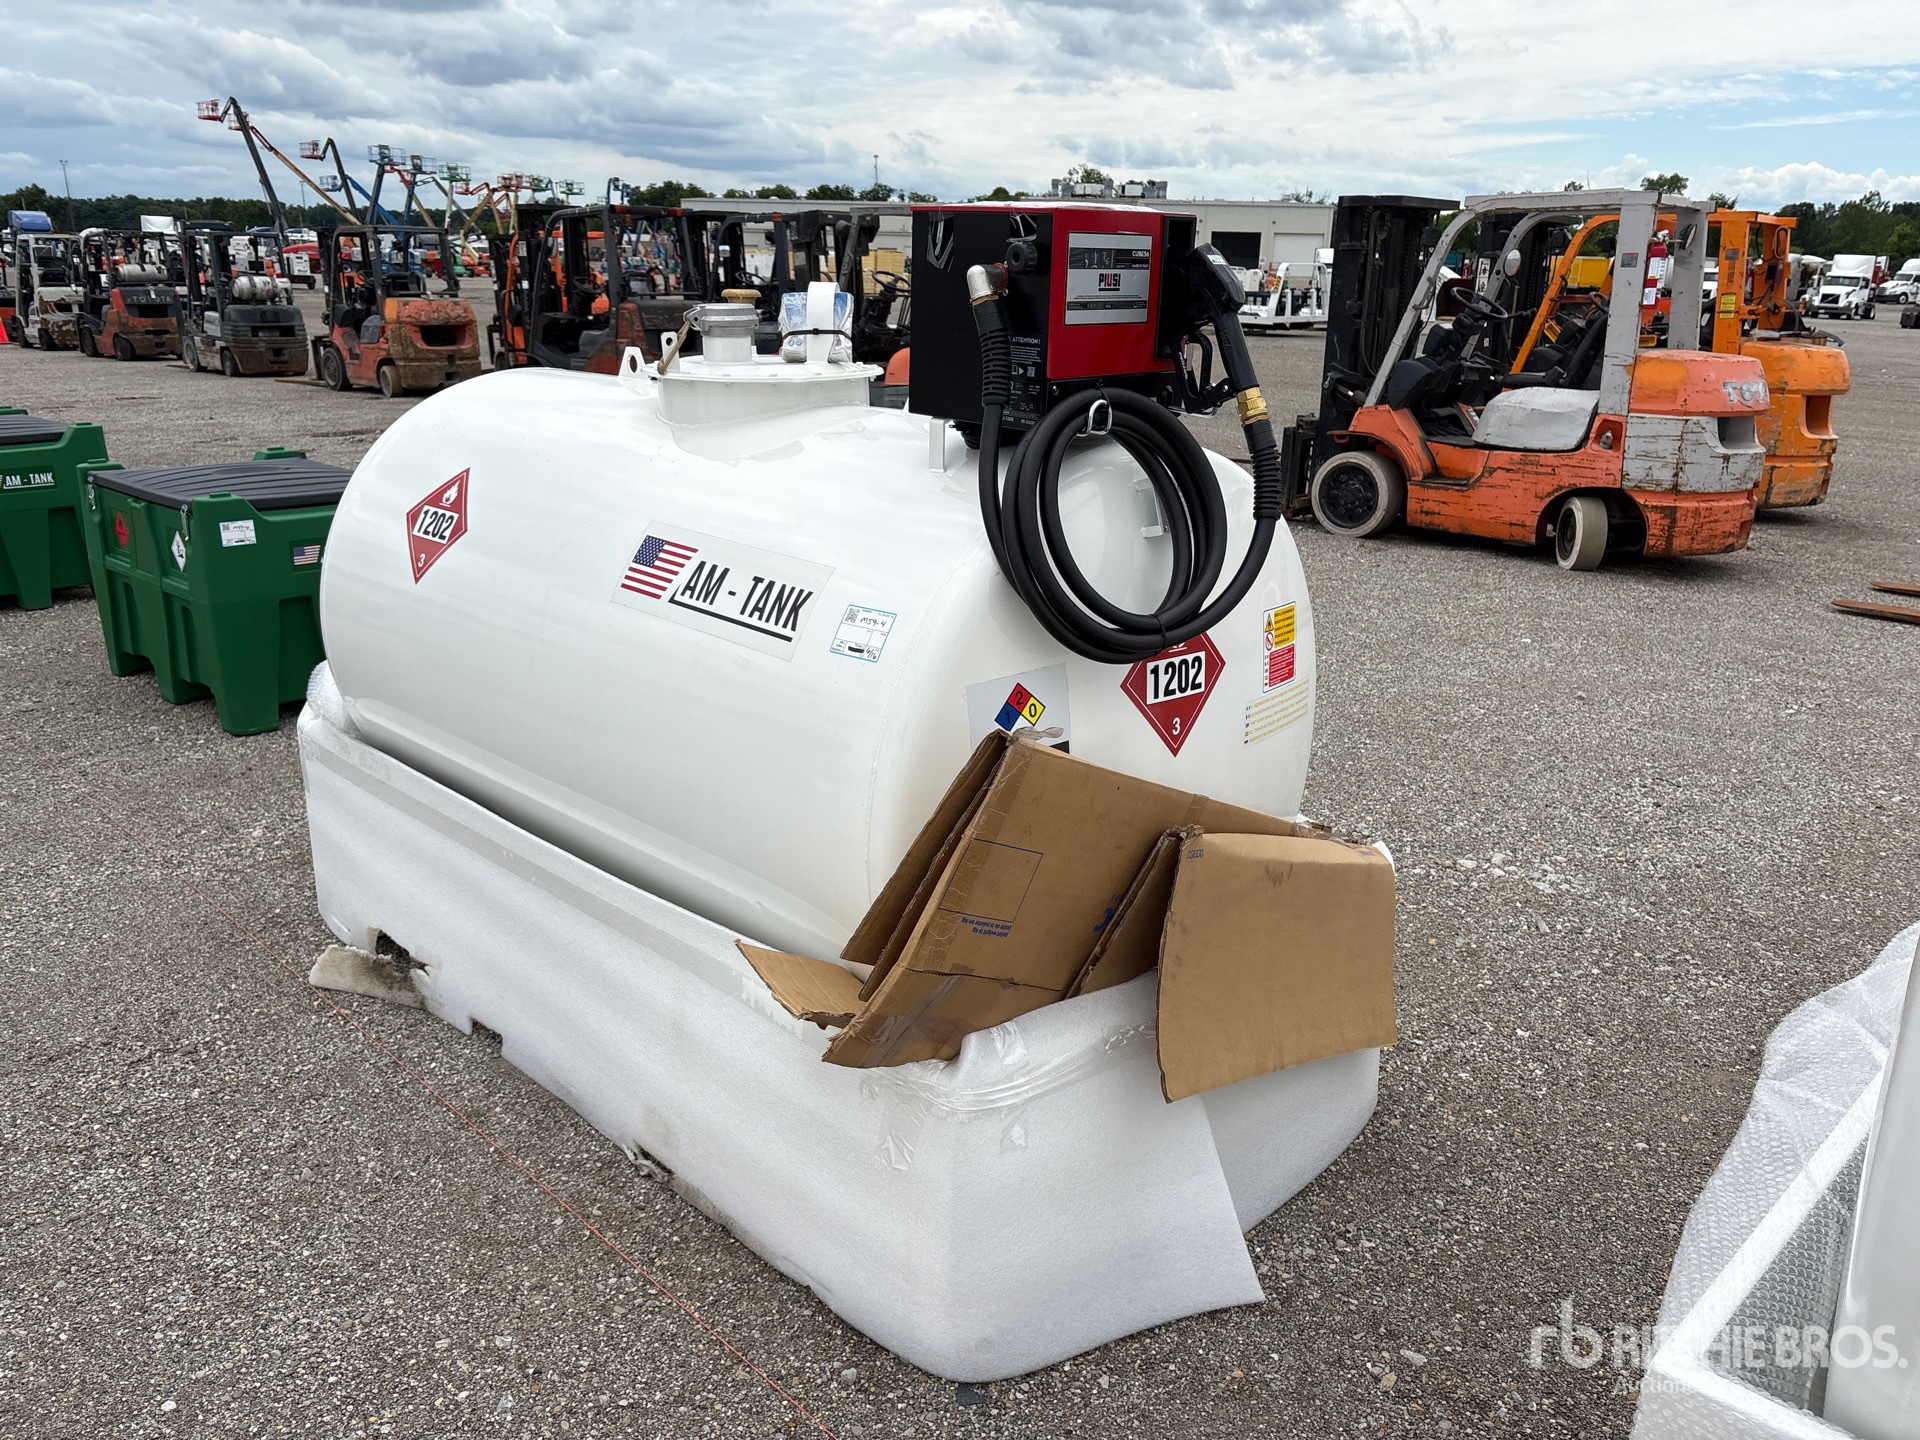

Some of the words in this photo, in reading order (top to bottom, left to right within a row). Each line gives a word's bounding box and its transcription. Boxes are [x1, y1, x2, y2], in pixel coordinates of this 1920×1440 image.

[1098, 273, 1120, 288] PIUSI
[6, 474, 21, 486] AM
[29, 472, 54, 484] TANK
[417, 508, 455, 541] 1202
[418, 553, 426, 568] 3
[680, 560, 730, 606] AM
[740, 575, 814, 632] TANK
[1150, 656, 1203, 700] 1202
[1015, 690, 1024, 706] 2
[1004, 710, 1010, 724] 1
[1028, 703, 1038, 718] 0
[1172, 717, 1180, 736] 3
